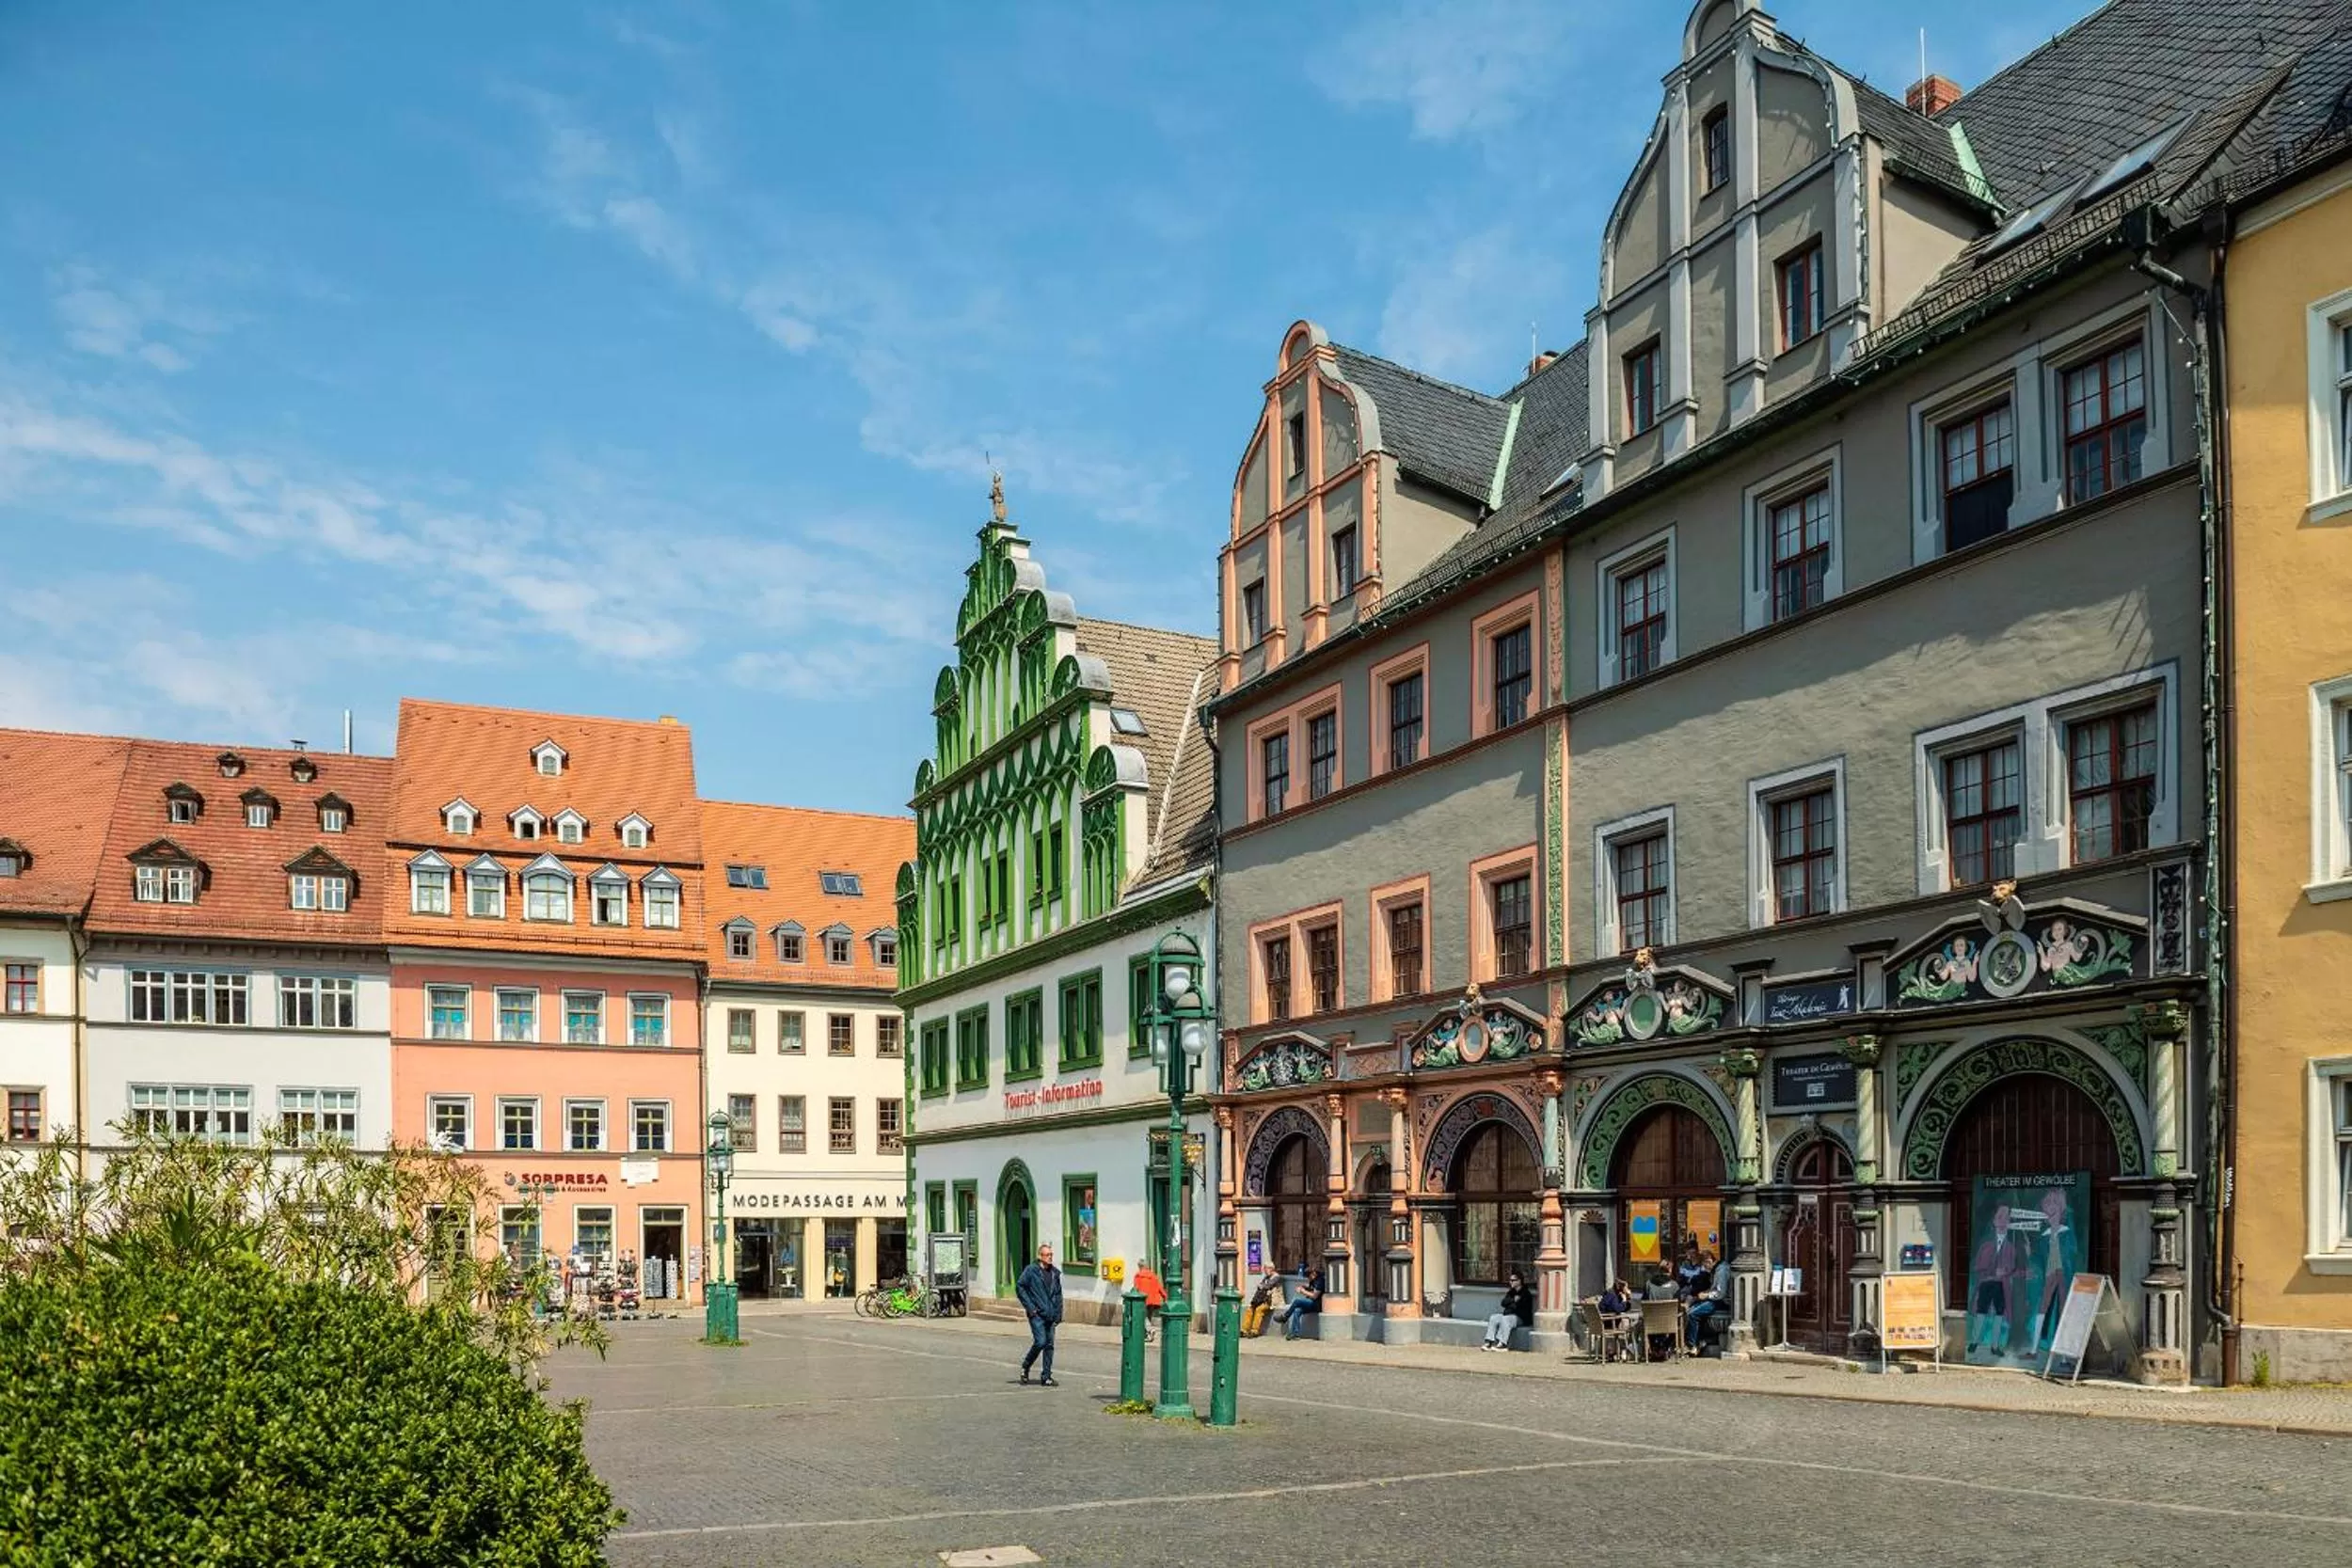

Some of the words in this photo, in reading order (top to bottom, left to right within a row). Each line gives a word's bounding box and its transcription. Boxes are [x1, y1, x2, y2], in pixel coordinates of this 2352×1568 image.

[1985, 1176, 2021, 1188] THEATER
[733, 1194, 854, 1208] MODEPASSAGE
[862, 1195, 887, 1208] AM
